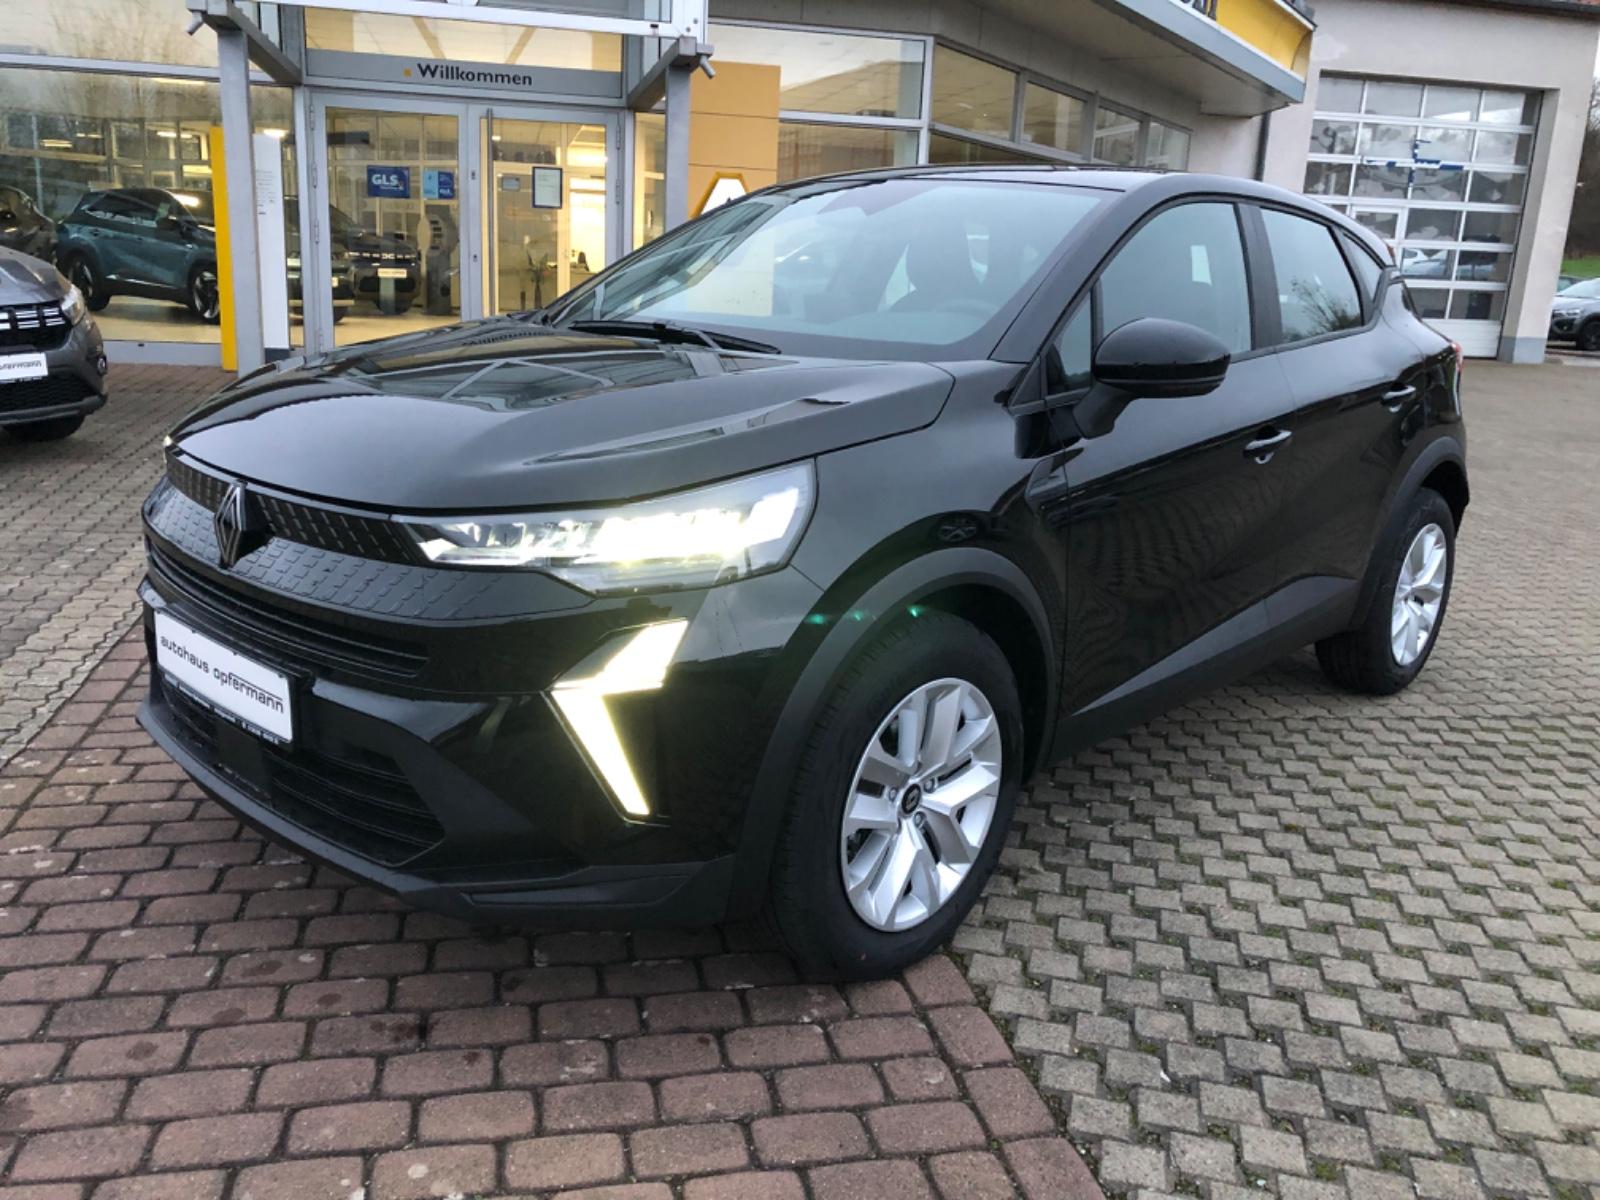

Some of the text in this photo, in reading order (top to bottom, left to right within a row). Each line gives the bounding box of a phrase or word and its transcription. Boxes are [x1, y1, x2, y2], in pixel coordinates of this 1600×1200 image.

[417, 63, 533, 85] Willkommen
[371, 174, 399, 186] GLS
[161, 636, 284, 713] autohaus opfermann
